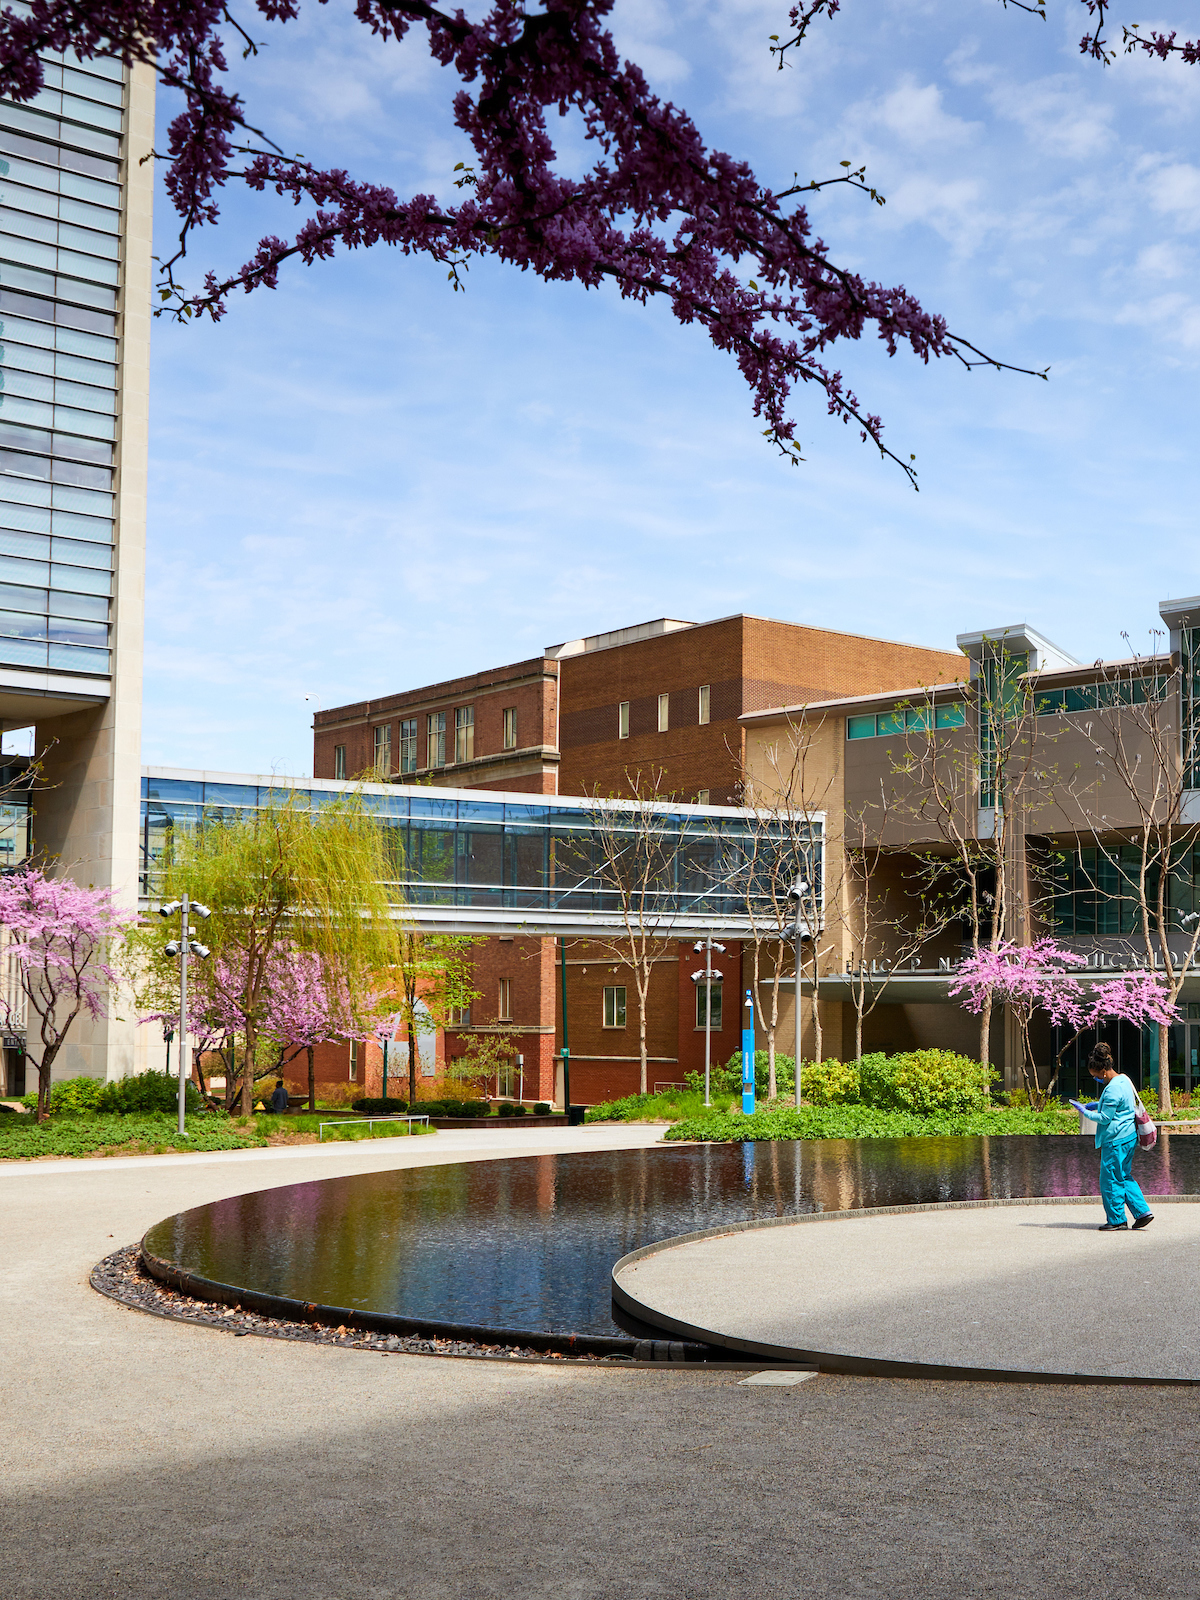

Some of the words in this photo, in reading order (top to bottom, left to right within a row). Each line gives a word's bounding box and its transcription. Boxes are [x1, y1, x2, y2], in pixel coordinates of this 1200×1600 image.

[846, 957, 892, 973] ERIC
[800, 1213, 826, 1221] WITHOUT
[864, 1208, 875, 1216] AND
[877, 1206, 896, 1214] NEVER
[897, 1205, 916, 1213] STOPS
[944, 1202, 956, 1210] AND
[959, 1201, 990, 1209] SWEETEST
